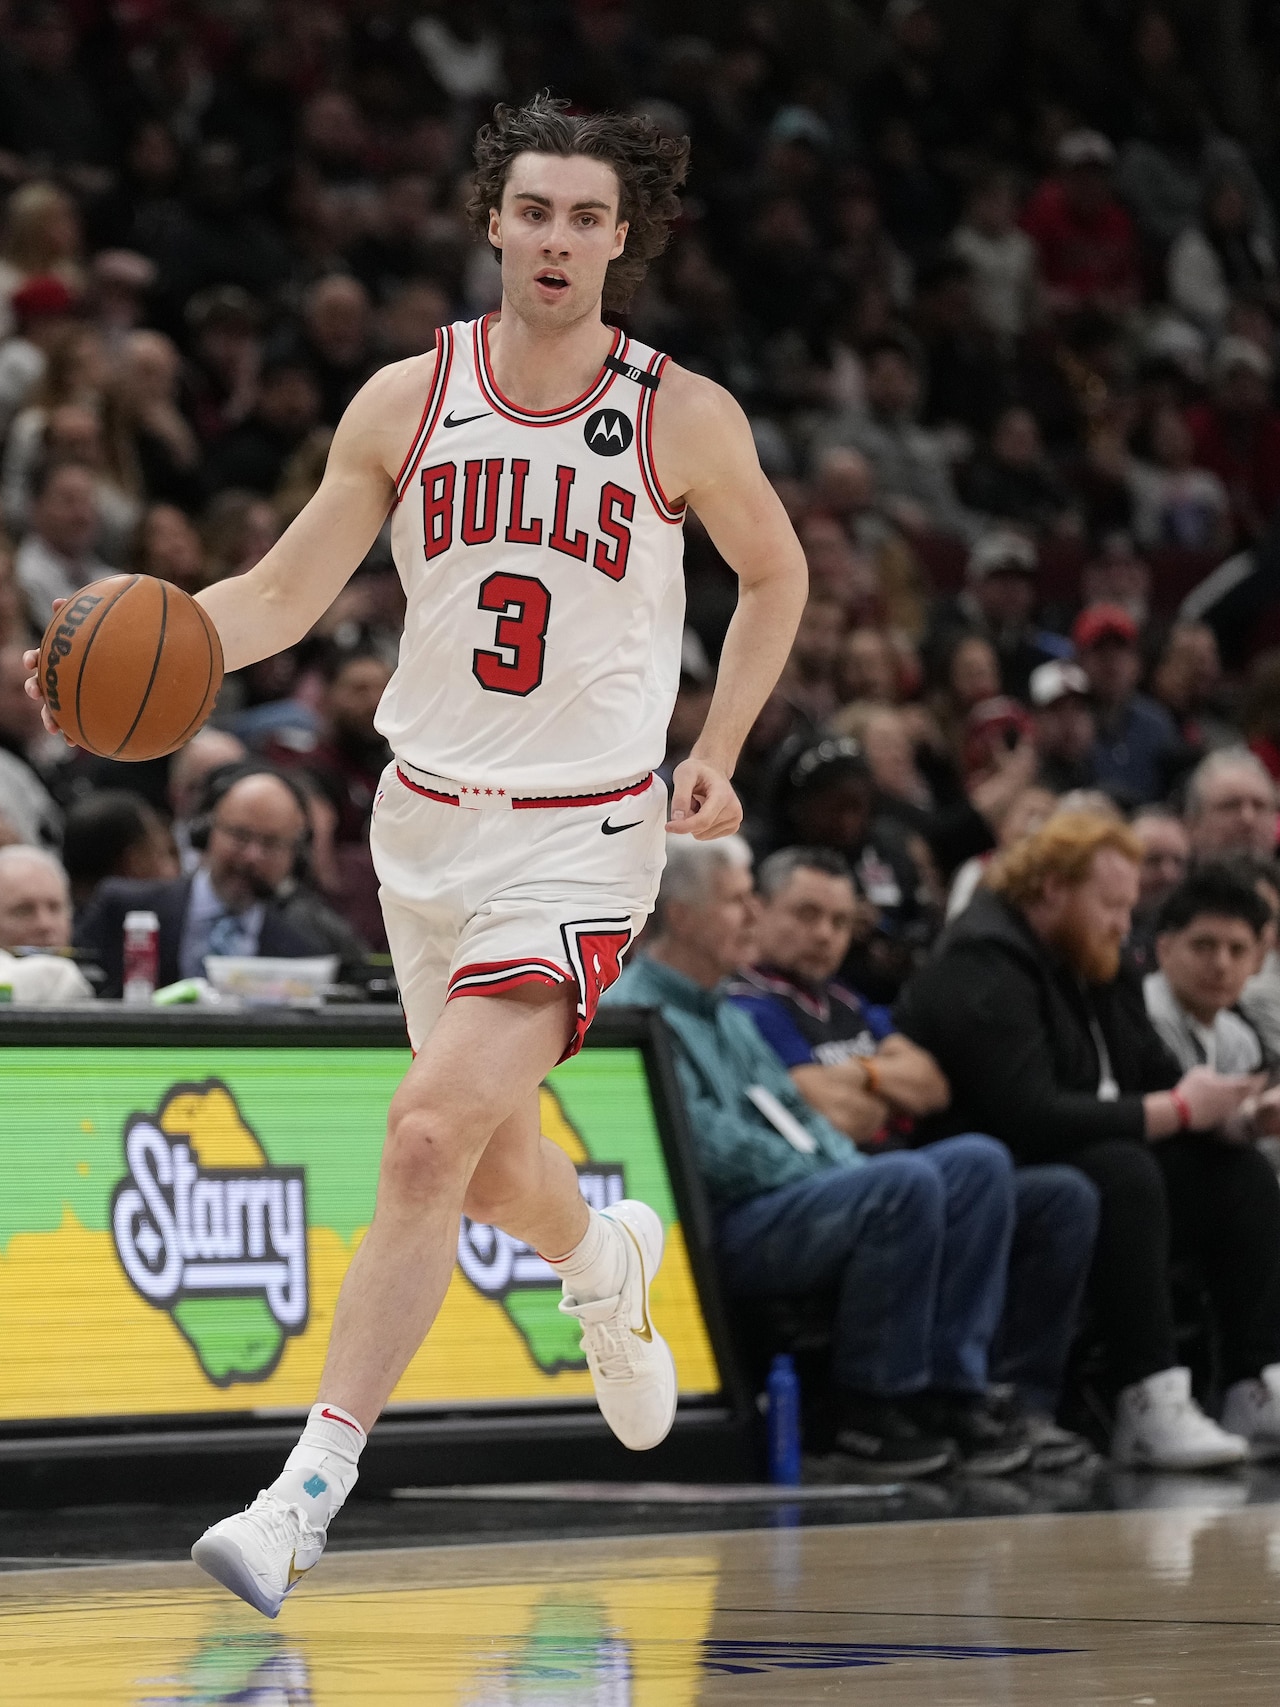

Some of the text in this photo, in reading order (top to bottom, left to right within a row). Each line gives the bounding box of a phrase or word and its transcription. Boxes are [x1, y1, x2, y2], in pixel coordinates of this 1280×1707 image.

[625, 367, 641, 381] 10
[421, 458, 636, 583] BULLS
[45, 594, 105, 712] Wilson
[473, 571, 552, 697] 3
[113, 1121, 308, 1327] Starry
